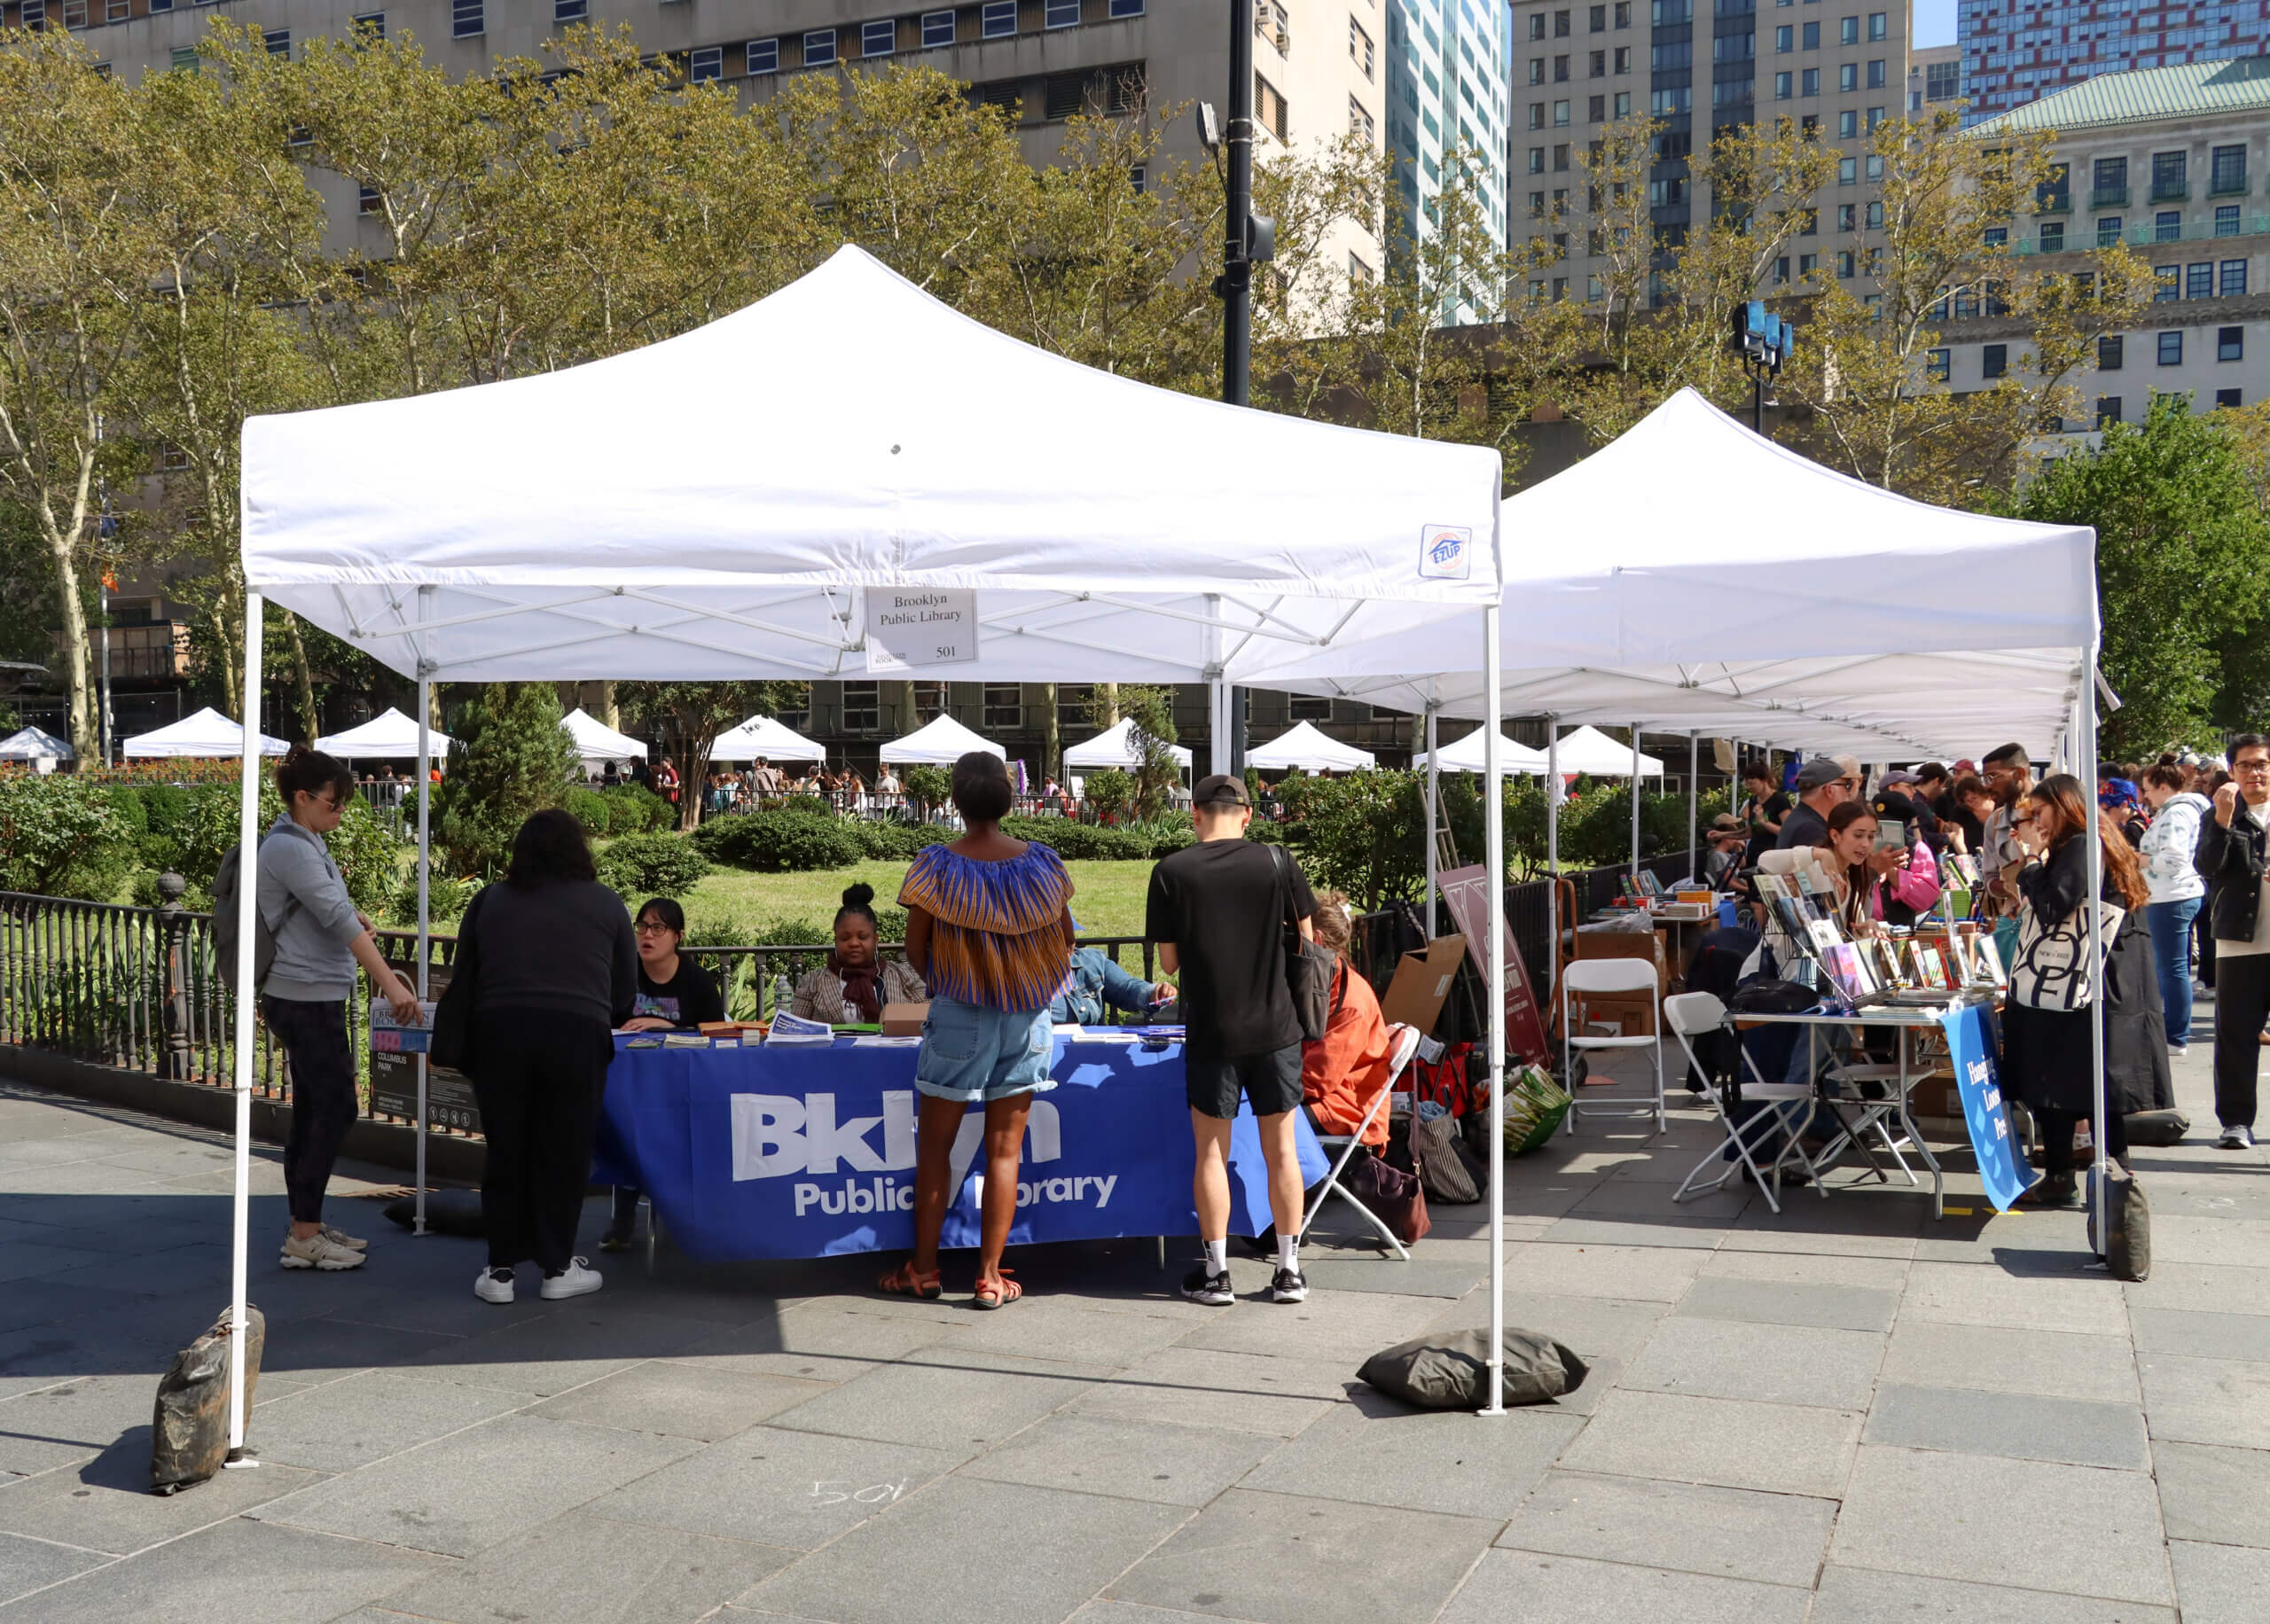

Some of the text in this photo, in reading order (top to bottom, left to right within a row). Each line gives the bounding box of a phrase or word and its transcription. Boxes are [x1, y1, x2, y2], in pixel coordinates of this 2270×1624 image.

[894, 593, 948, 608] Brooklyn
[880, 610, 962, 626] Public Library
[936, 645, 956, 658] 501
[378, 1051, 407, 1064] COLUMBUS
[378, 1062, 392, 1072] PARK
[794, 1176, 916, 1217] Public
[809, 1478, 908, 1505] 501
